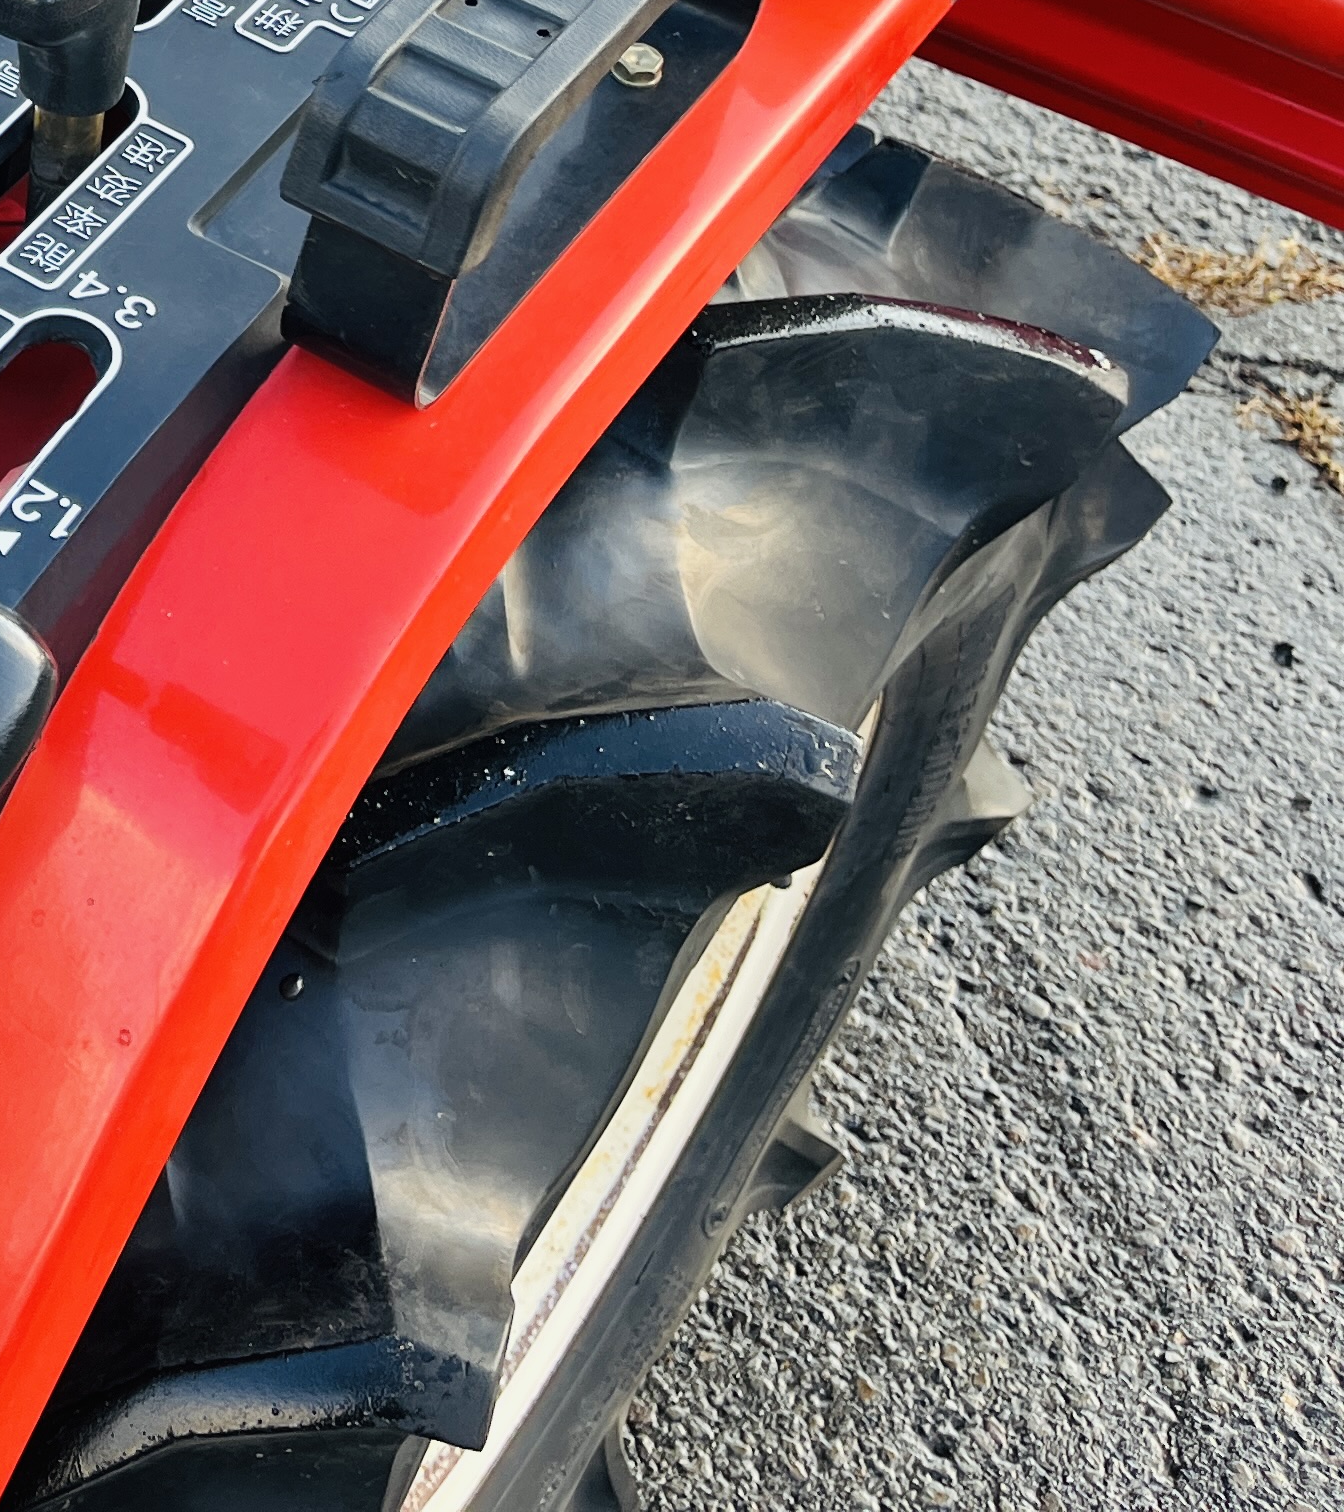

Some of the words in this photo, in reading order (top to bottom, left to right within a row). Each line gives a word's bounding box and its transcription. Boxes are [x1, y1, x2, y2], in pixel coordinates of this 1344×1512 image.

[20, 132, 176, 274] 能率変速
[68, 270, 157, 329] 3.4
[11, 480, 82, 540] 1.2
